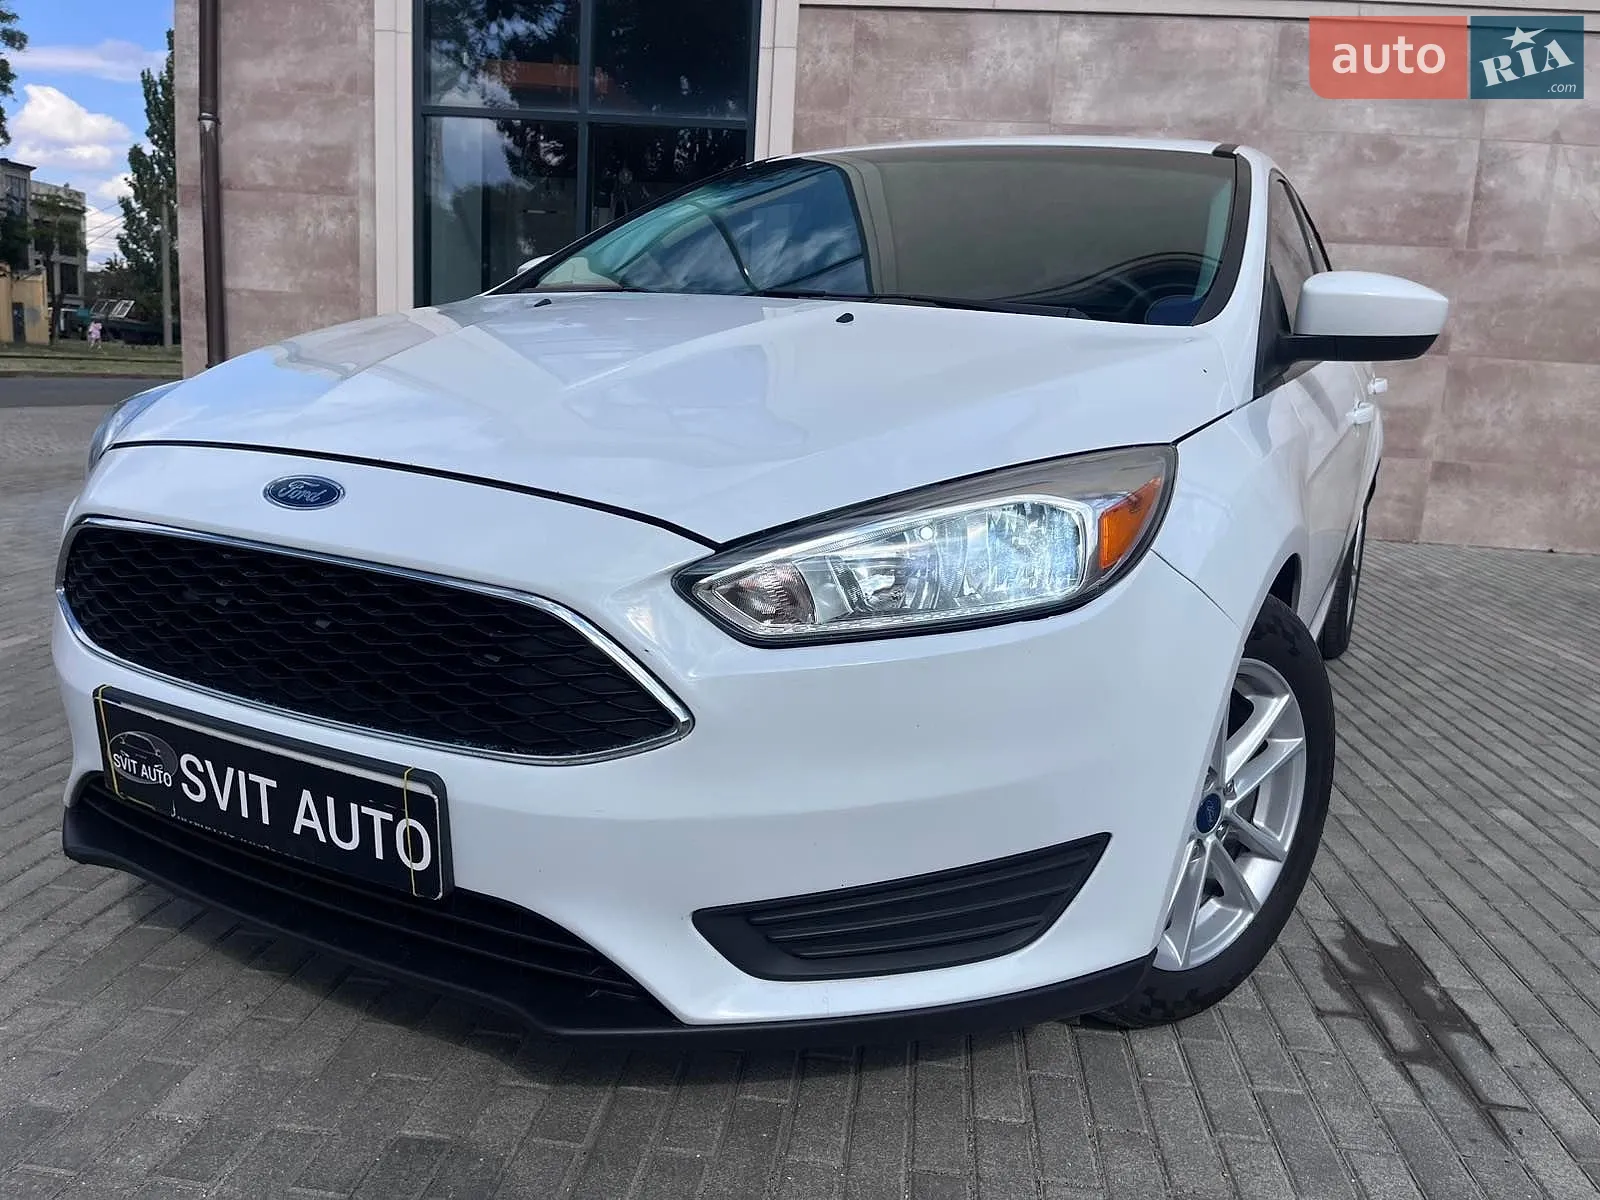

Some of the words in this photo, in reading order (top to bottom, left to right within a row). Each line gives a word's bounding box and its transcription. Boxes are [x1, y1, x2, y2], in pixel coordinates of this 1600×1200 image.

[278, 480, 327, 502] Ford
[113, 753, 137, 774] SVIT
[141, 764, 172, 787] AUTO
[179, 753, 277, 826] SVIT
[293, 789, 432, 872] AUTO
